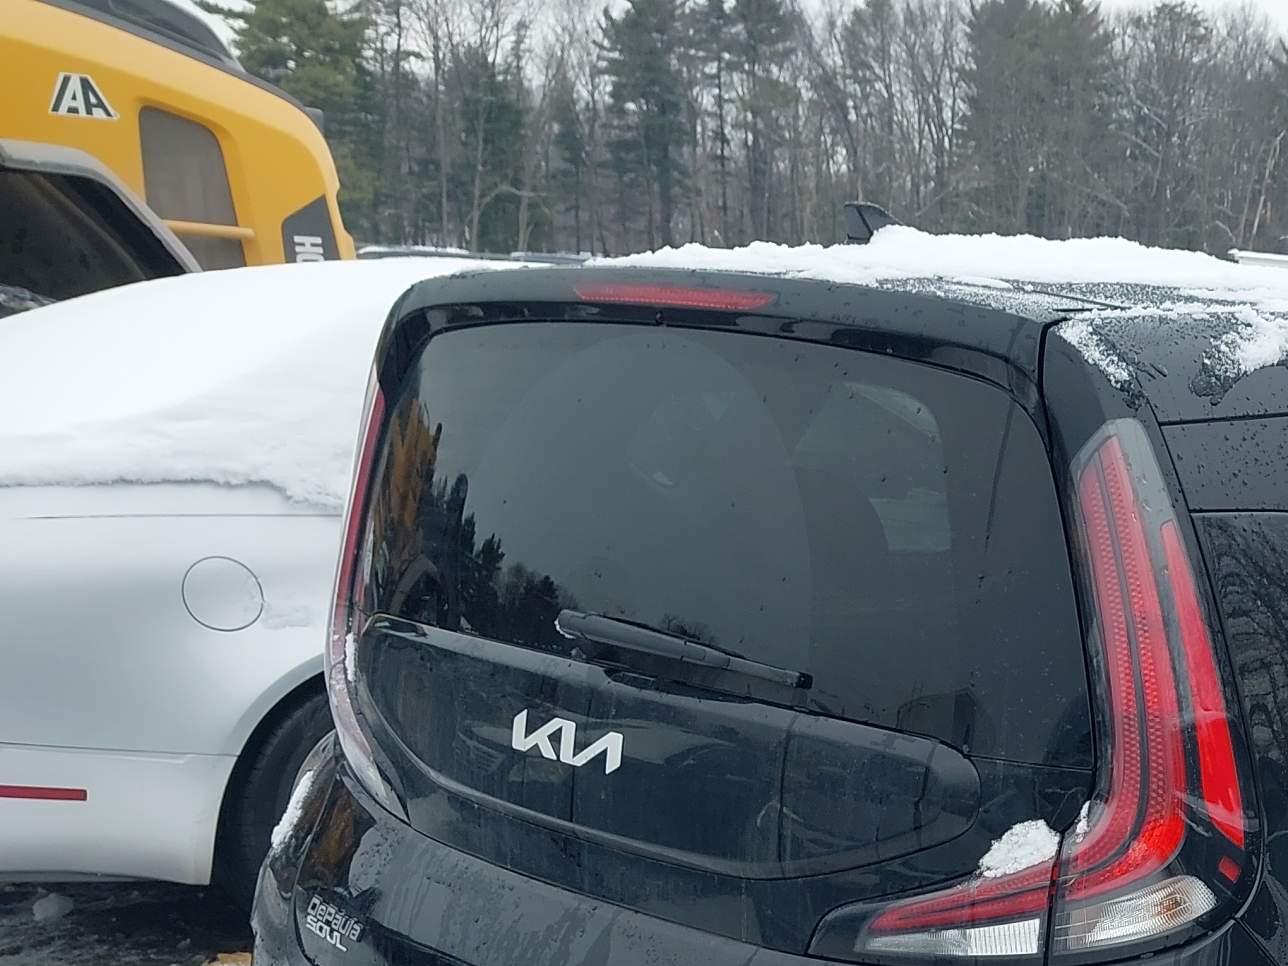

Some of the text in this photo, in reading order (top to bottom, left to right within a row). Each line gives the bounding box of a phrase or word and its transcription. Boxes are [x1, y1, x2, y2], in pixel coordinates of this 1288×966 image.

[512, 708, 624, 775] KIA
[305, 914, 347, 952] SOUL
[307, 895, 362, 941] DePaula
